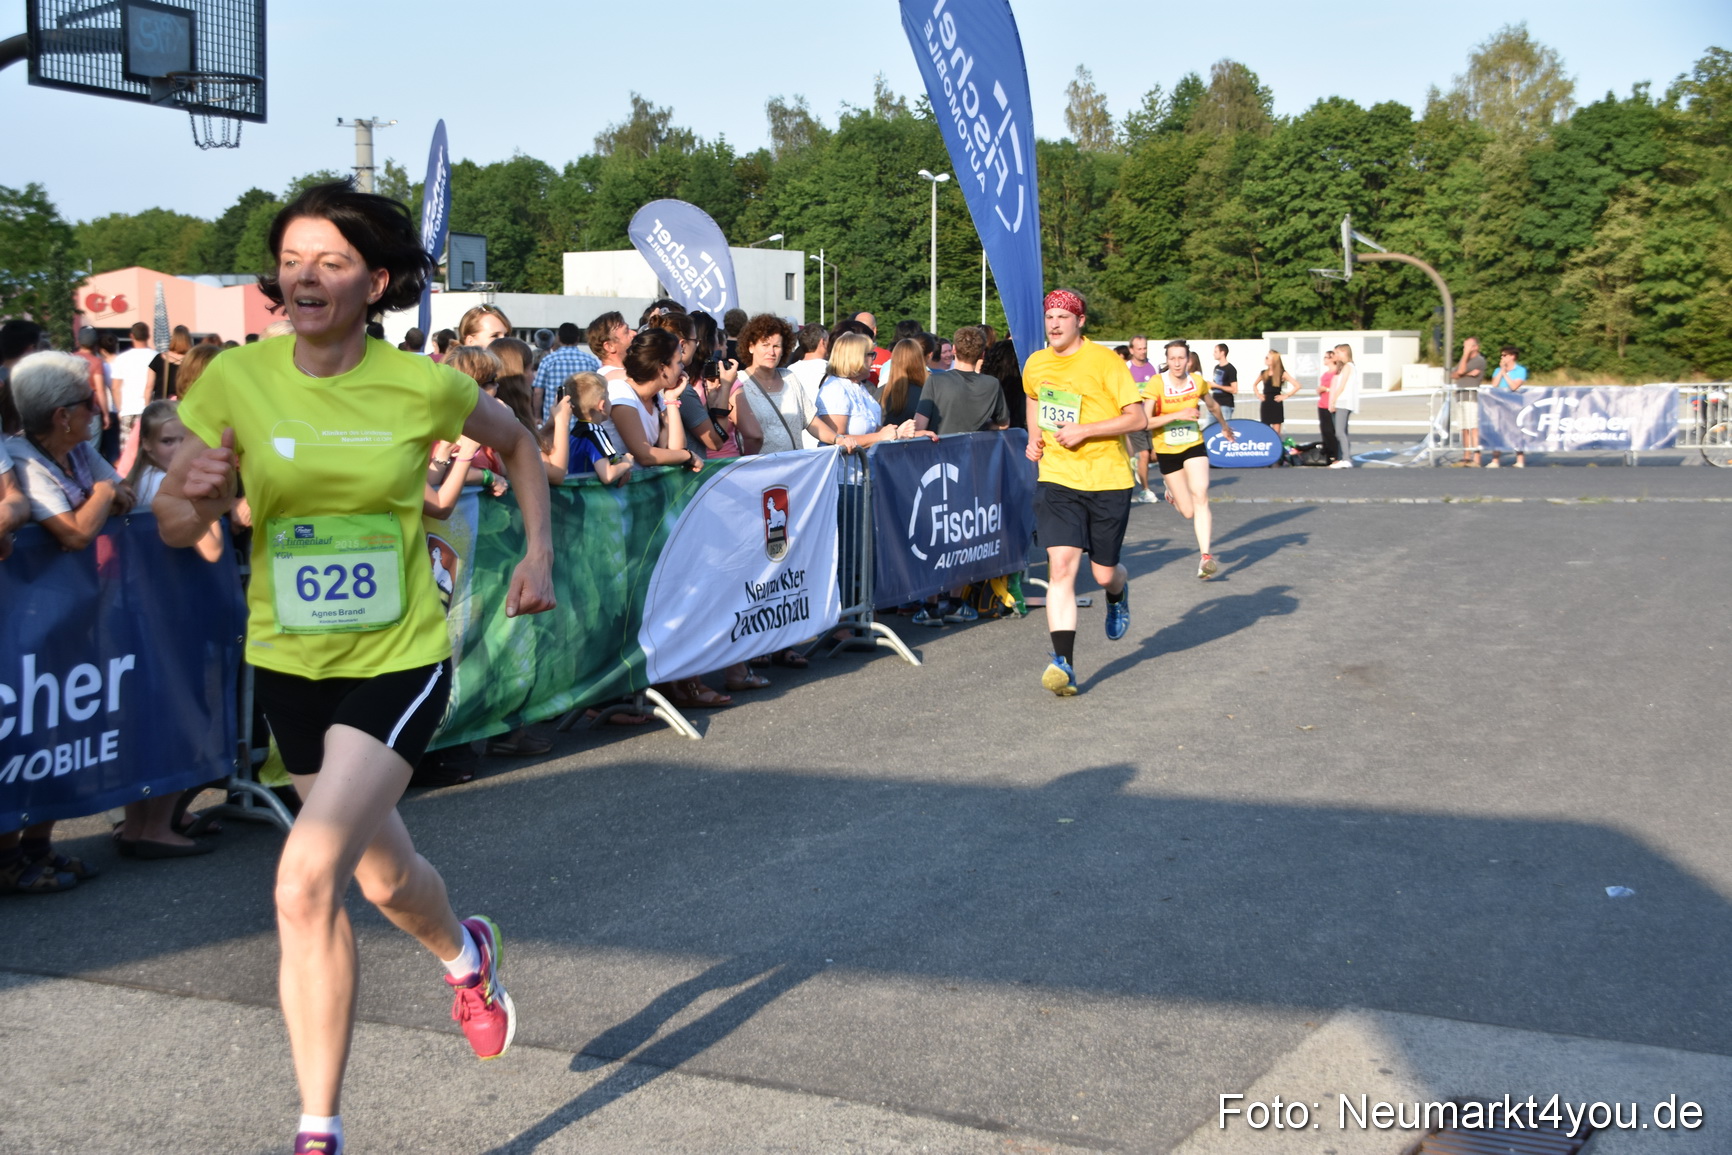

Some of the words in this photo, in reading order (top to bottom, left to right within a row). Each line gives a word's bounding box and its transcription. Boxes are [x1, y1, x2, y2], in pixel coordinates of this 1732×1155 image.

[1041, 405, 1075, 423] 1335
[1537, 412, 1637, 432] Fischer
[1170, 426, 1191, 437] 887
[1545, 432, 1627, 441] AUTOMOBILE
[1219, 440, 1272, 452] Fischer
[933, 539, 1001, 570] AUTOMOBILE
[296, 562, 378, 602] 628
[311, 610, 337, 618] Agnes
[338, 608, 366, 616] Brandl
